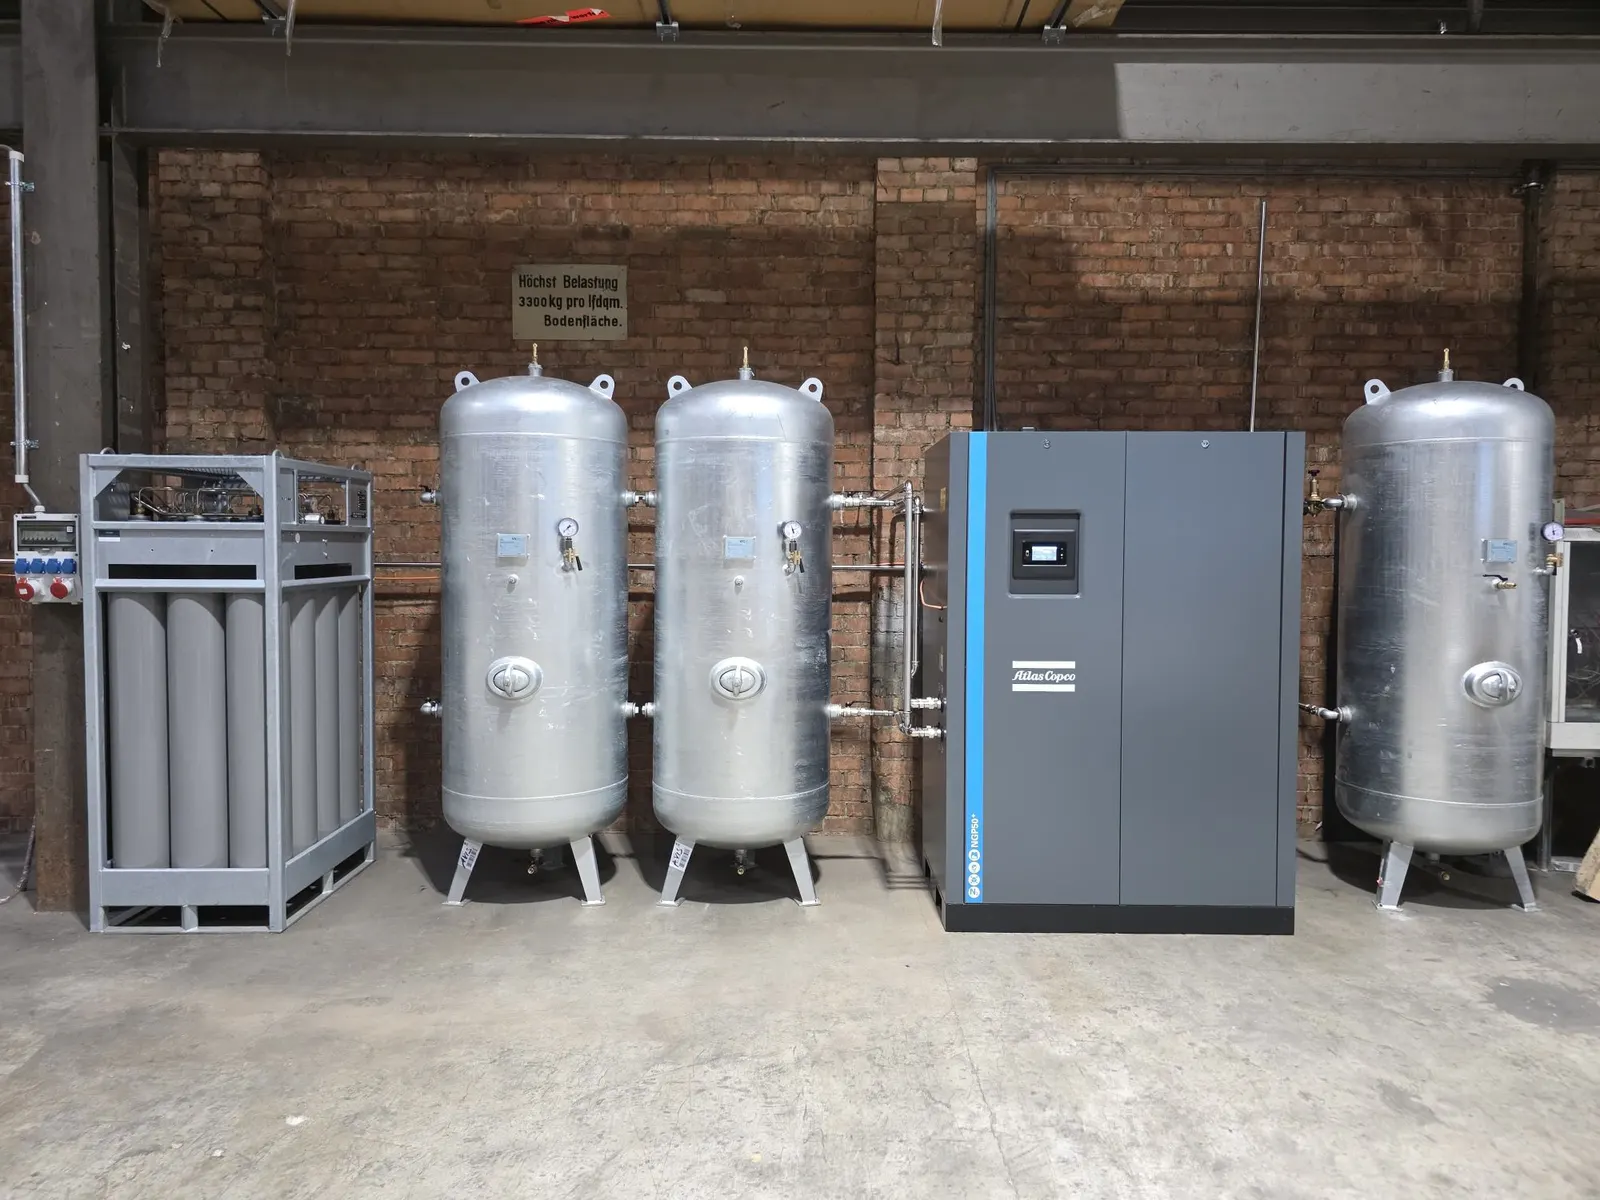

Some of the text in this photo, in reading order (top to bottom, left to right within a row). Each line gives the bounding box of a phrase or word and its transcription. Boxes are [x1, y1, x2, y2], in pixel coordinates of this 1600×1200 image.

[519, 274, 618, 292] Höchst Belastung
[566, 298, 585, 310] pro
[544, 315, 622, 329] Bodenfläche.
[1012, 670, 1076, 683] Atlas Copco
